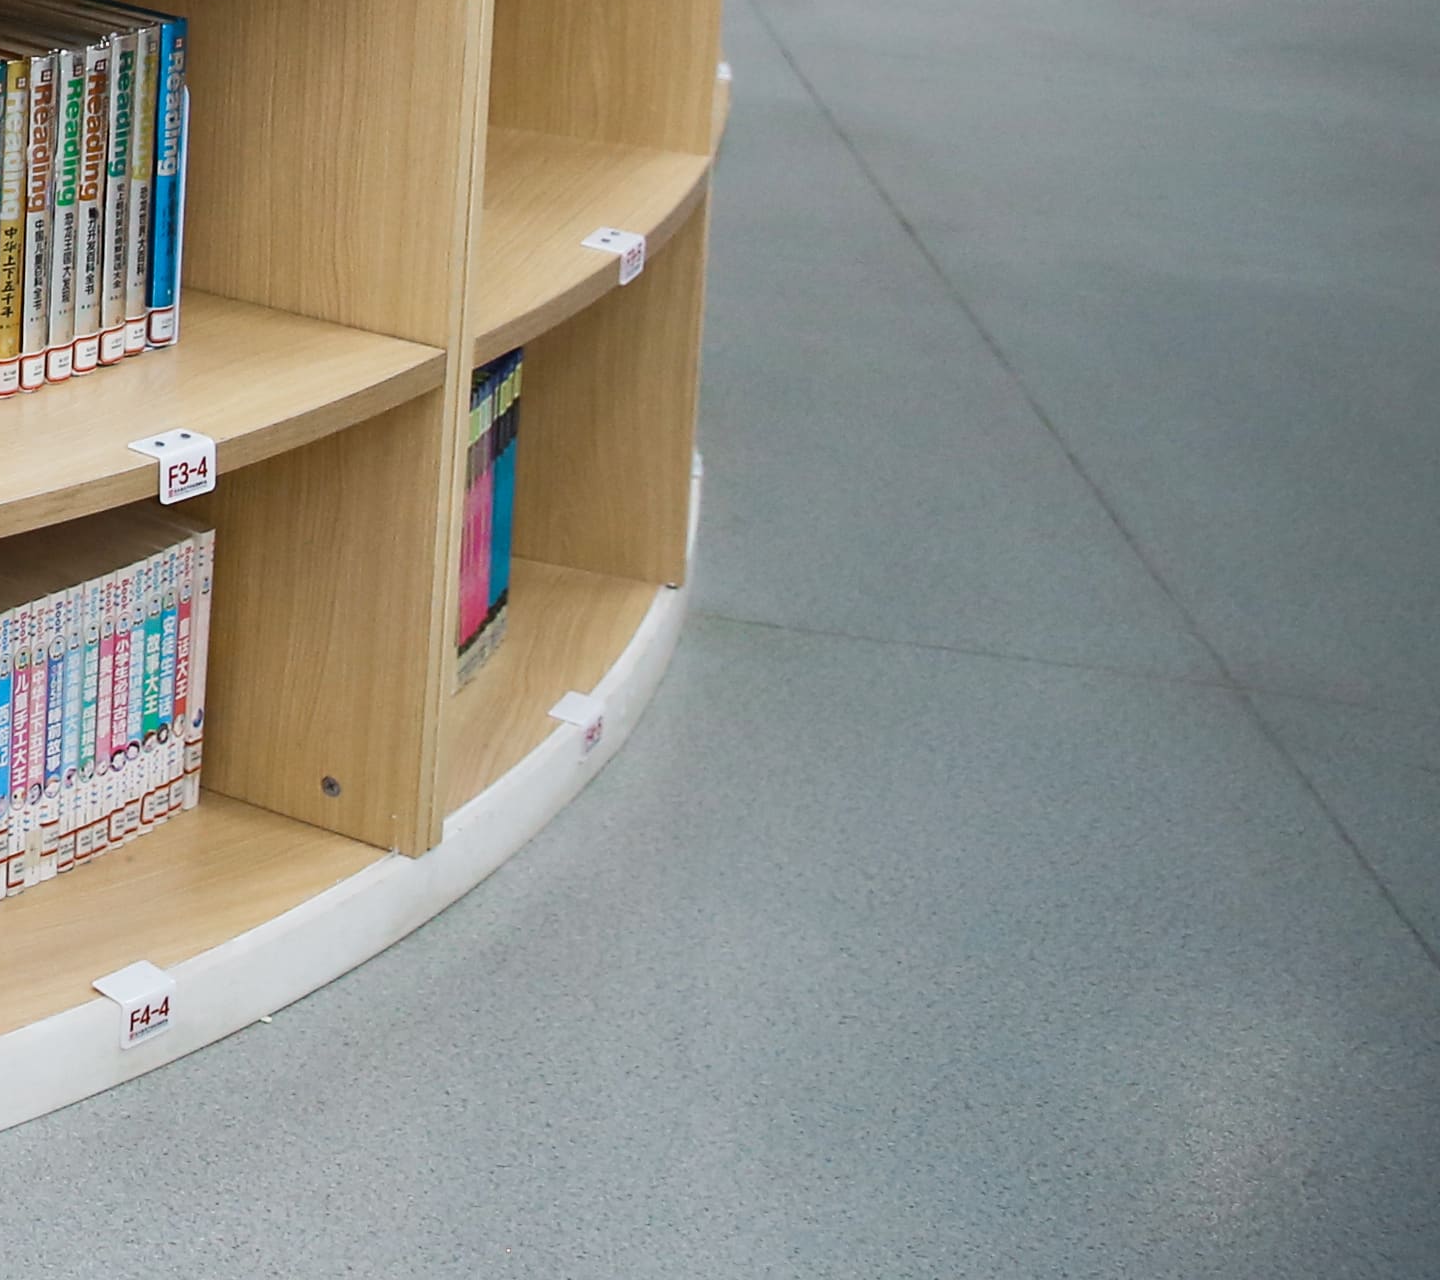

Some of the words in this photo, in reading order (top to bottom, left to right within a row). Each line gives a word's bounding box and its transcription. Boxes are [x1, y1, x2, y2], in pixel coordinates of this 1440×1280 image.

[56, 77, 83, 206] Reading
[79, 73, 106, 201] Reading
[0, 226, 18, 318] 中华上下五千年
[169, 456, 207, 488] F3-4
[145, 634, 160, 714] 故事大王
[12, 674, 28, 787] 儿童手工大王
[130, 996, 169, 1032] F4-4
